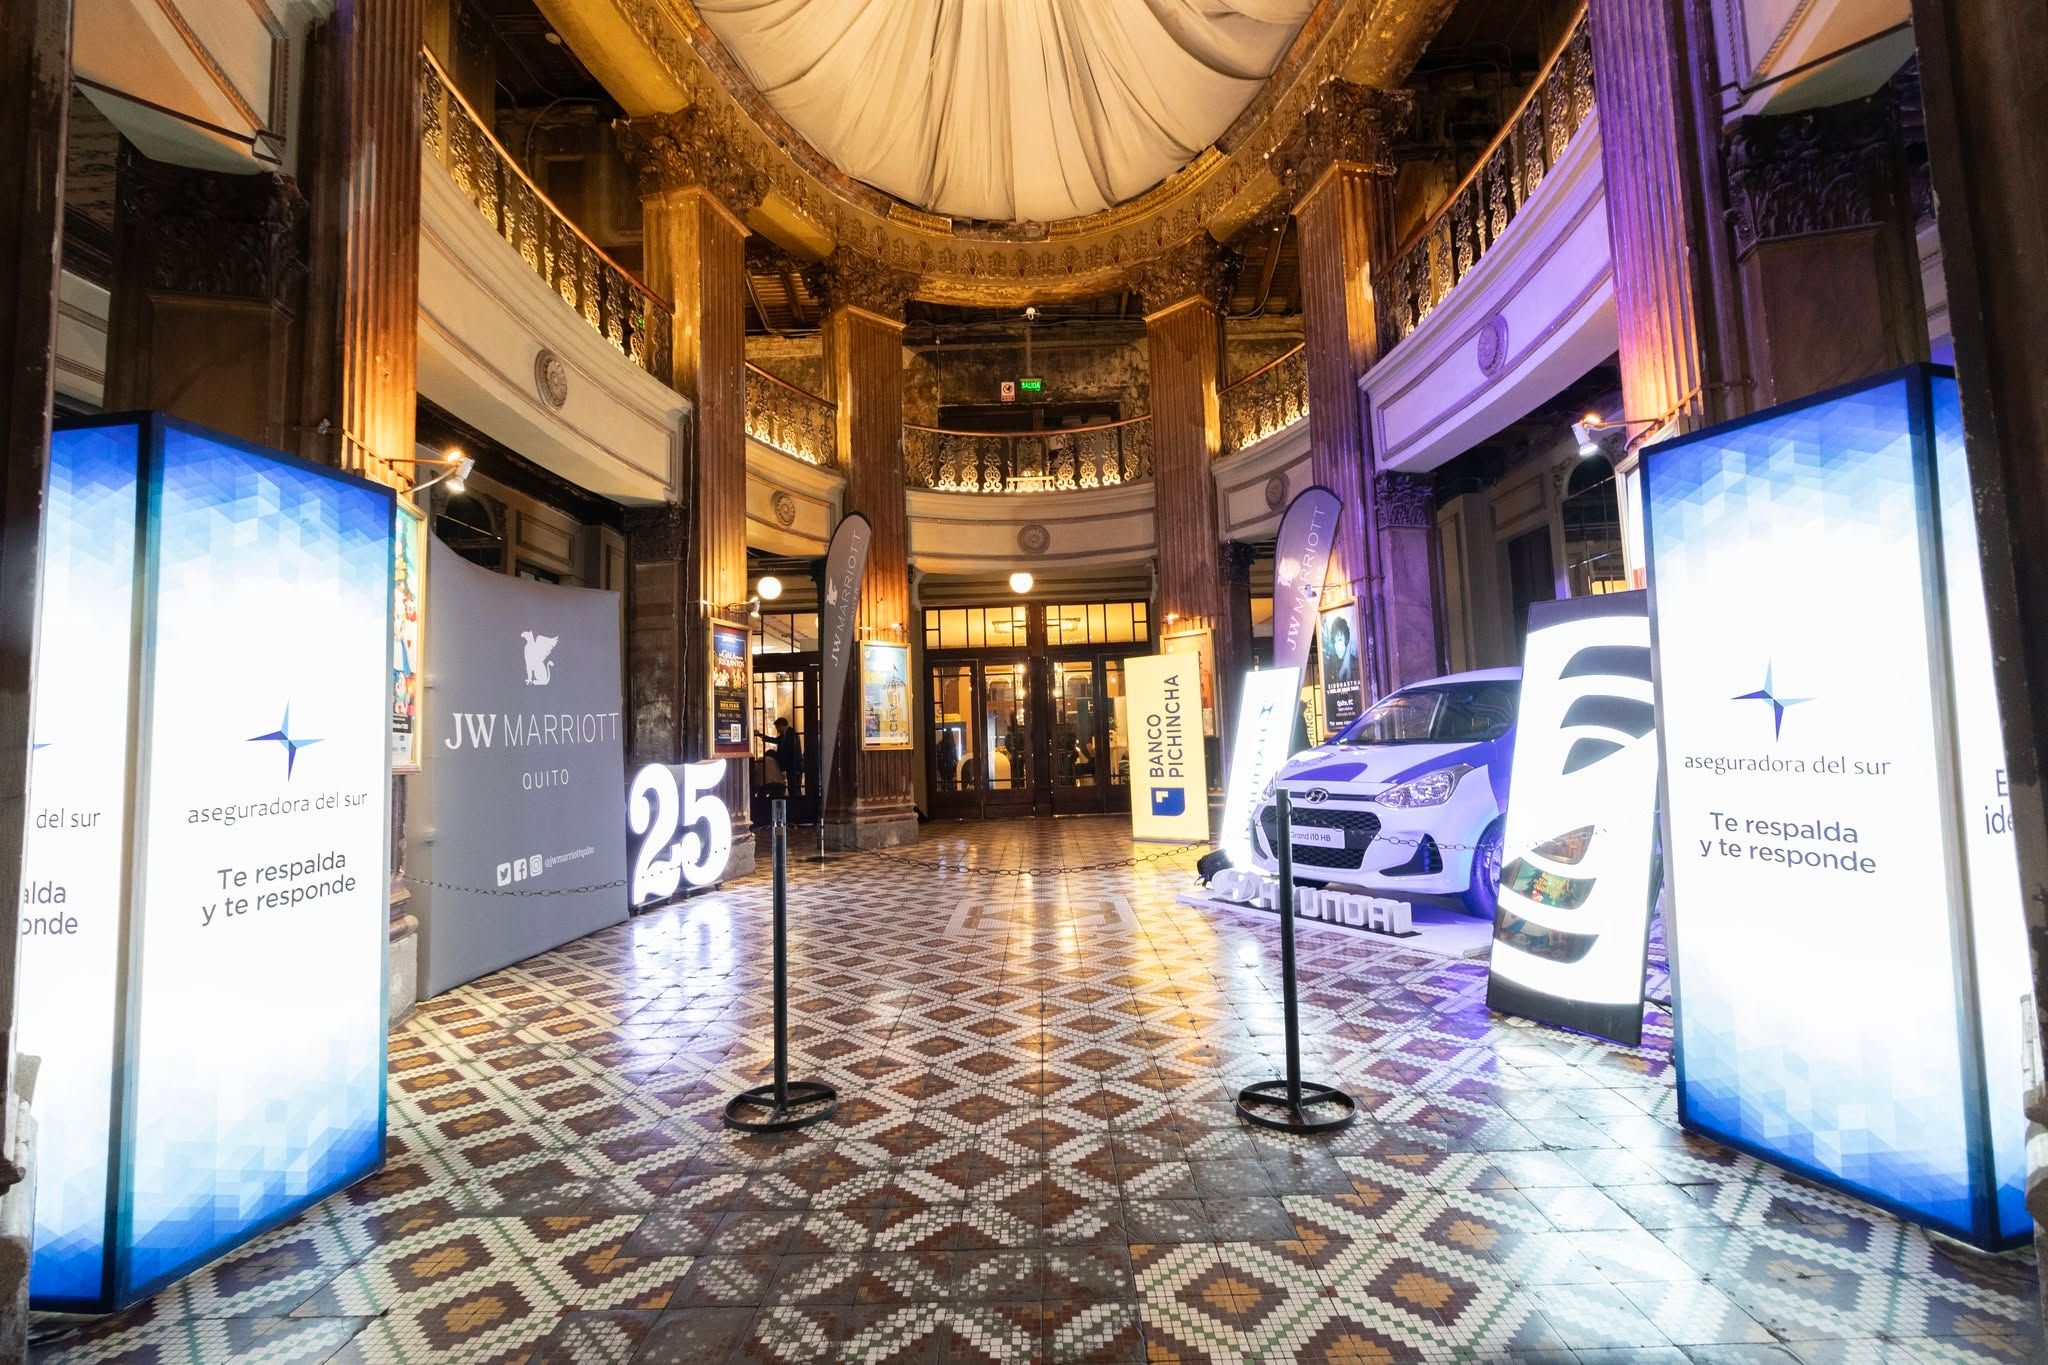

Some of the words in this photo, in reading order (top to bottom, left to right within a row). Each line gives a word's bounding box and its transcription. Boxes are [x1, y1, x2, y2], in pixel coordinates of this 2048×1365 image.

[1293, 505, 1325, 615] MARRIOTT
[836, 529, 862, 632] MARRIOTT
[831, 633, 843, 667] JW
[1286, 616, 1301, 651] JW
[444, 712, 497, 750] JW
[504, 712, 619, 747] MARRIOTT
[1163, 674, 1184, 778] PICHINCHA
[1146, 714, 1165, 778] BANCO
[522, 768, 570, 790] QUITO
[1684, 754, 1806, 776] aseguradora
[1812, 755, 1846, 774] del
[1854, 760, 1892, 776] sur
[36, 807, 65, 829] del
[70, 812, 101, 828] sur
[187, 797, 310, 826] aseguradora
[315, 792, 339, 810] del
[344, 792, 368, 807] sur
[1709, 811, 1739, 833] Te
[1745, 819, 1859, 844] respalda
[629, 758, 732, 905] 25
[1320, 834, 1331, 842] HB
[216, 868, 248, 890] Te
[255, 850, 347, 884] respalda
[1699, 839, 1713, 858] y
[1719, 838, 1742, 858] te
[1749, 845, 1877, 874] responde
[201, 903, 217, 927] y
[224, 897, 249, 918] te
[256, 873, 356, 911] responde
[1259, 882, 1413, 935] HUNDAI
